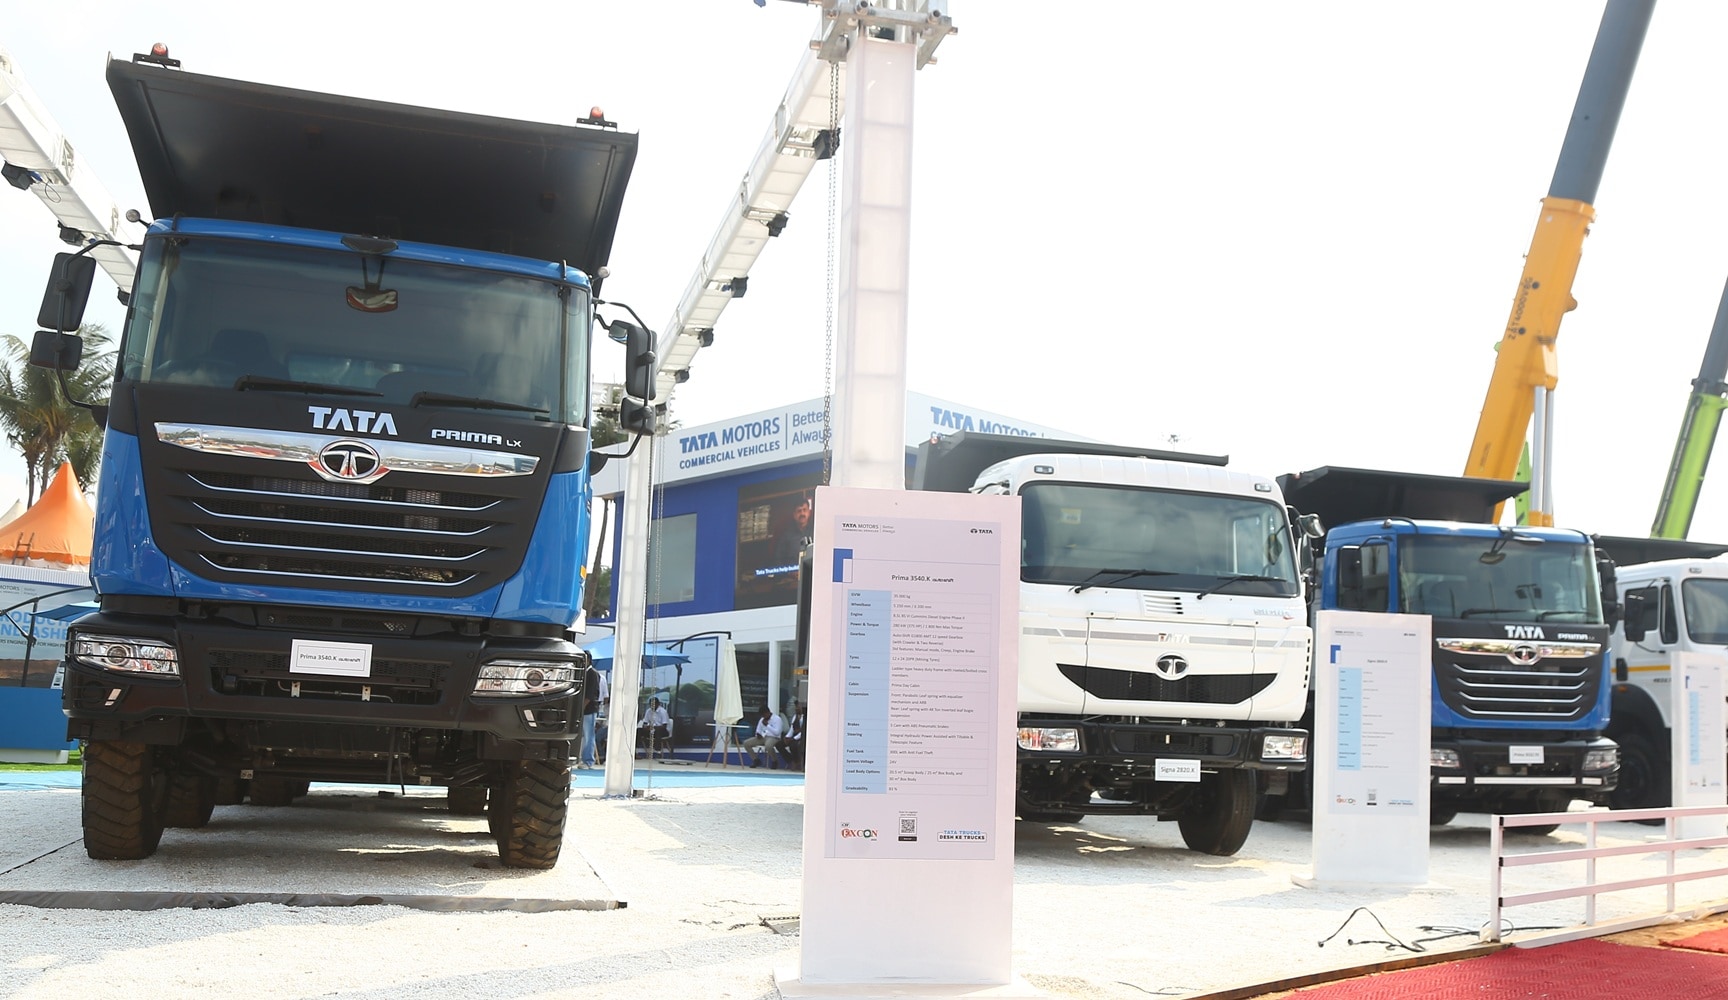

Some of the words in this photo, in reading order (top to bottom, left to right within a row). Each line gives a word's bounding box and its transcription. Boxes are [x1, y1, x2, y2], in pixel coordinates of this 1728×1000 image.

[308, 405, 398, 436] TATA
[931, 406, 974, 433] TATA
[431, 428, 502, 445] PRIMA
[506, 439, 521, 448] LX
[679, 431, 718, 454] TATA
[722, 417, 780, 445] MOTORS
[679, 451, 735, 469] COMMERCIAL
[737, 441, 780, 457] VEHICLES
[1504, 625, 1545, 639] TATA
[1557, 633, 1588, 641] PRIMA
